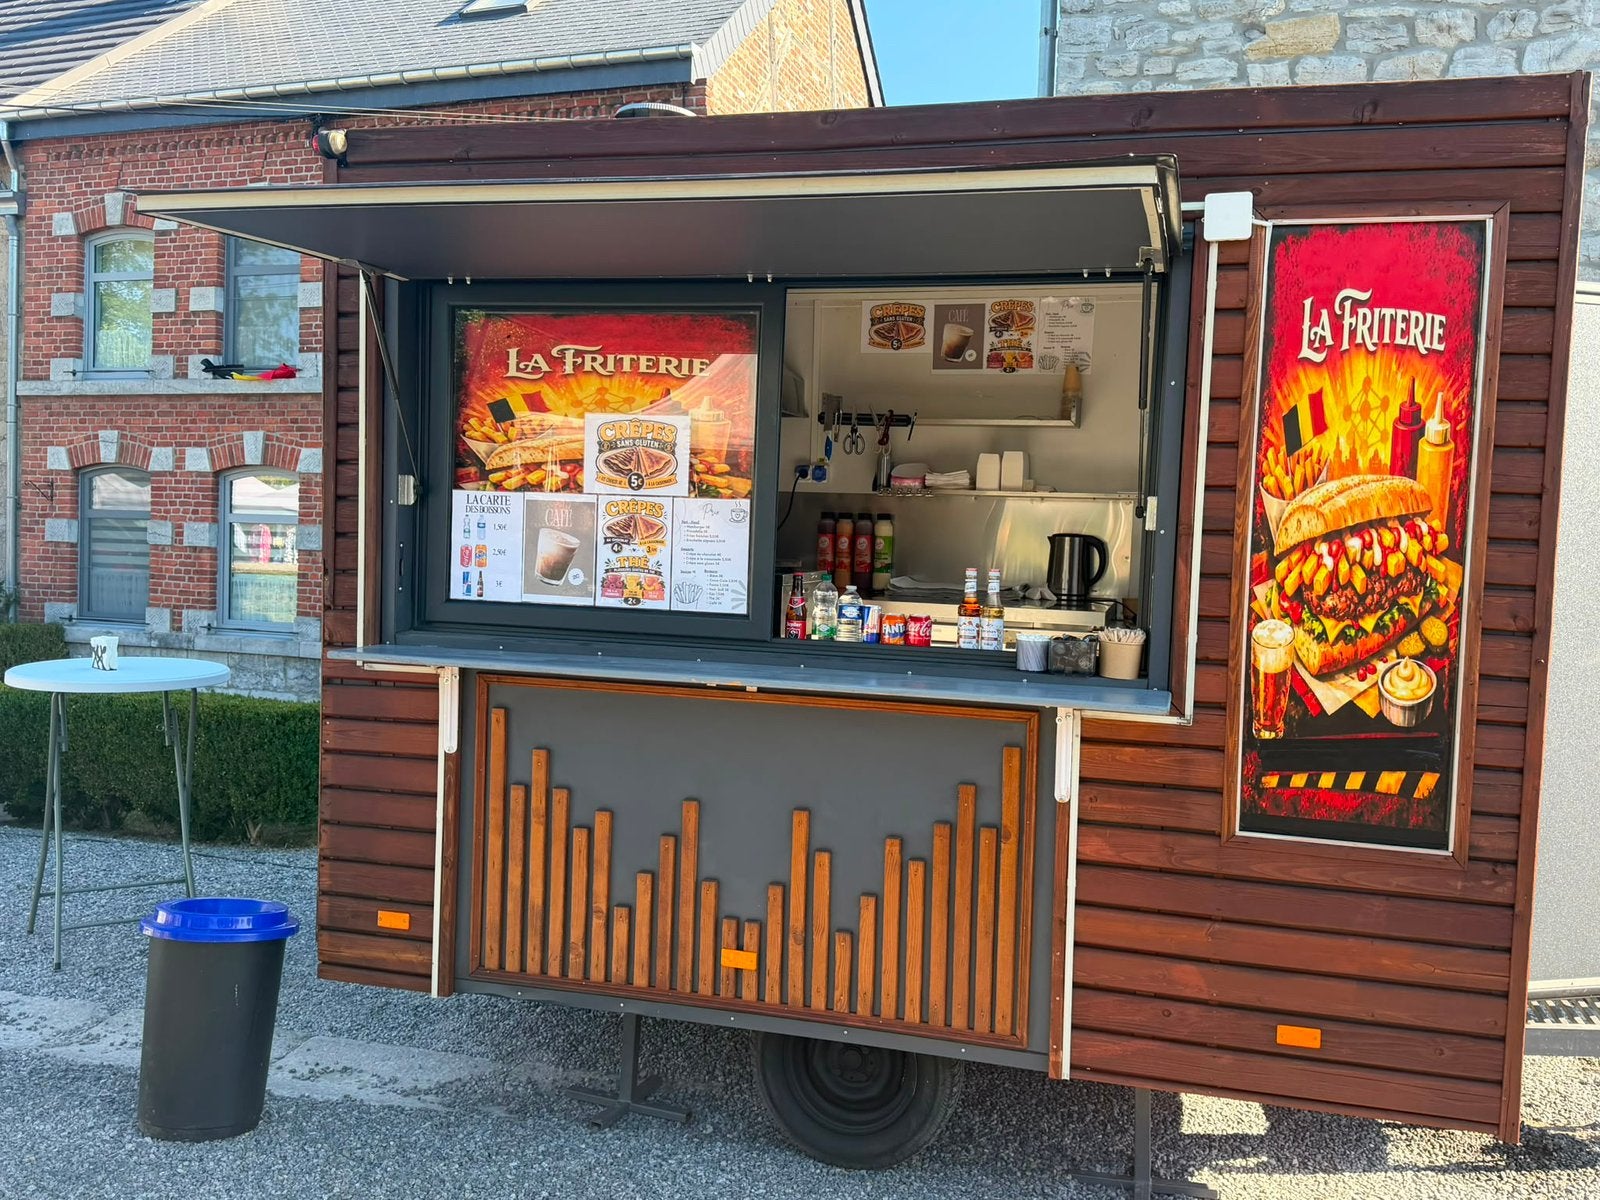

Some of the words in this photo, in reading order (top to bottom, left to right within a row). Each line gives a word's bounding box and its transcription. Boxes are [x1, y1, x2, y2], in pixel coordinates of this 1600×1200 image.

[1297, 295, 1335, 363] LA
[1334, 288, 1447, 355] FRITERIE
[503, 347, 552, 380] LA
[551, 344, 711, 379] FRITERIE
[600, 418, 676, 443] CRÊPES
[616, 439, 634, 449] SANS
[634, 439, 660, 449] GLUTEN
[466, 493, 479, 504] LA
[480, 494, 512, 506] CARTE
[605, 498, 665, 518] CRÊPES
[465, 505, 479, 513] DES
[479, 505, 511, 515] BOISSONS
[616, 555, 650, 569] THÉ
